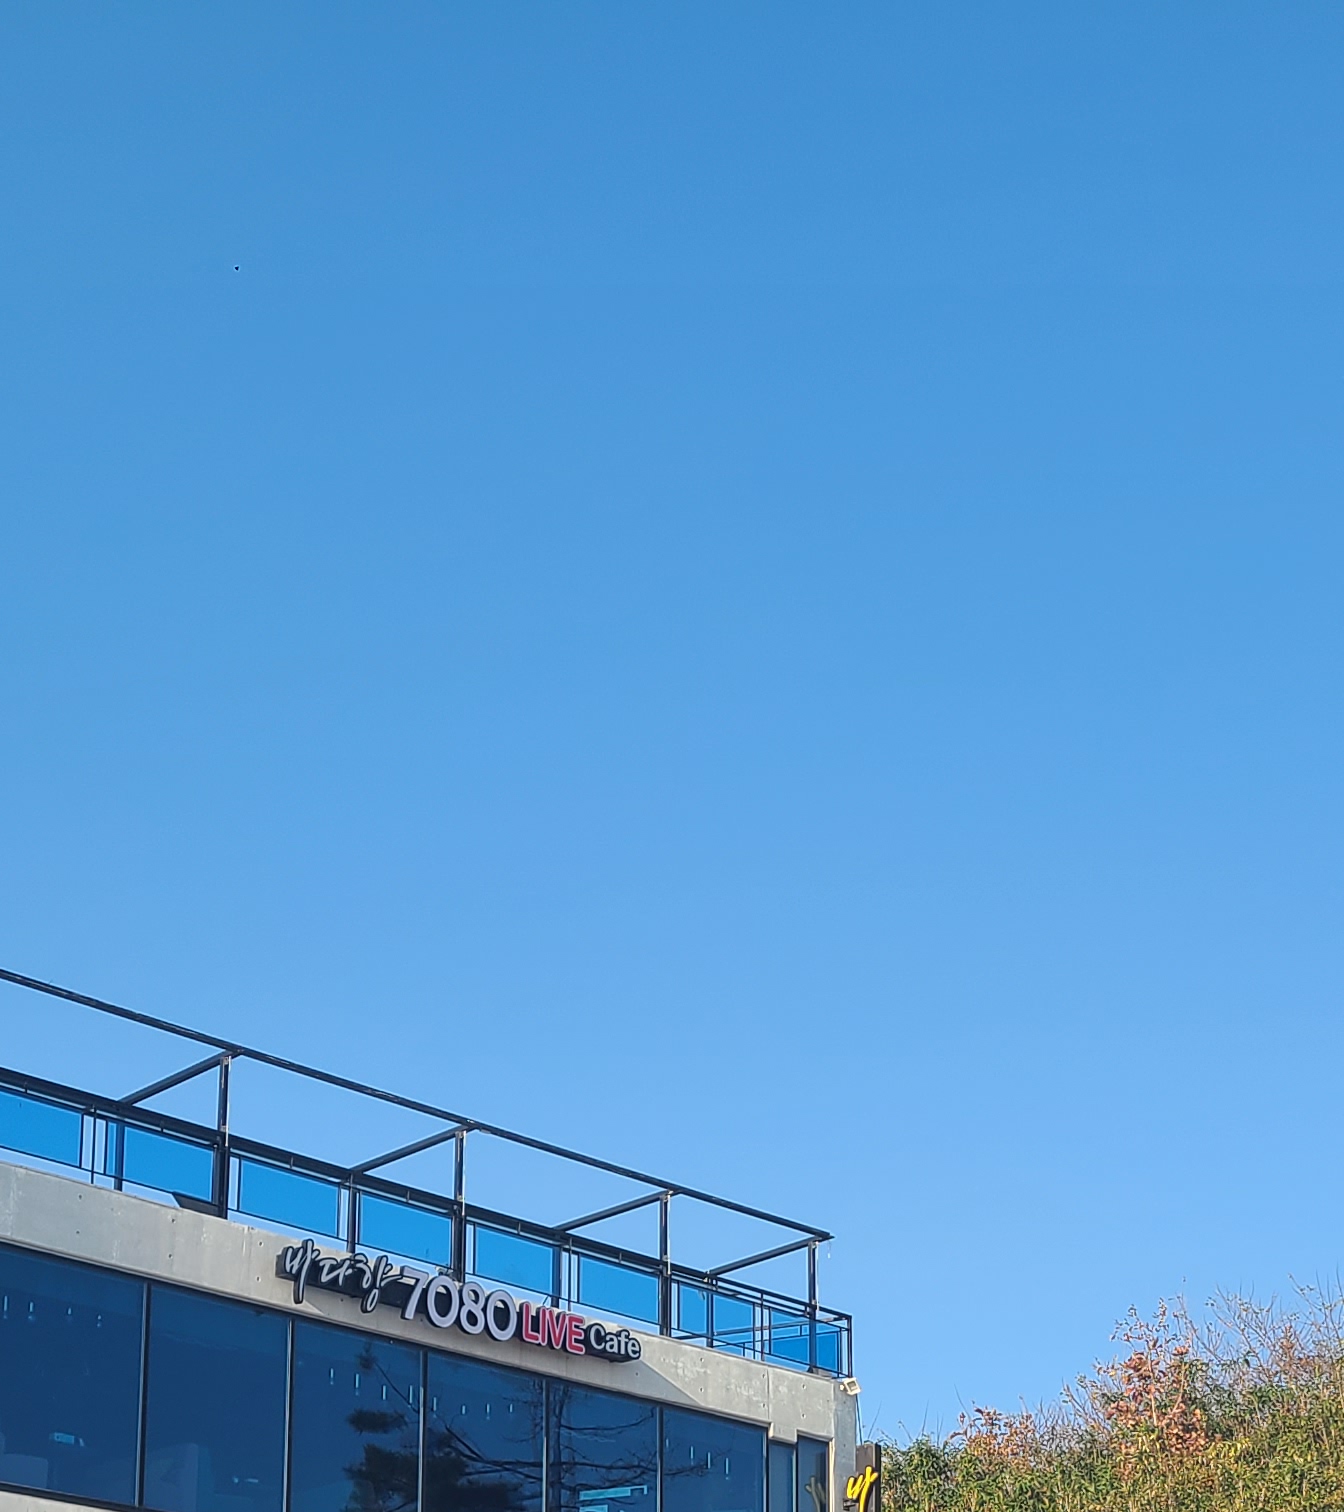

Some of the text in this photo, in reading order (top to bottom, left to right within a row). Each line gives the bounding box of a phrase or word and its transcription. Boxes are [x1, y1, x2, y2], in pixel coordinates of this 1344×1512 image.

[284, 1239, 641, 1359] 바다향 7080 LIVE Cafe
